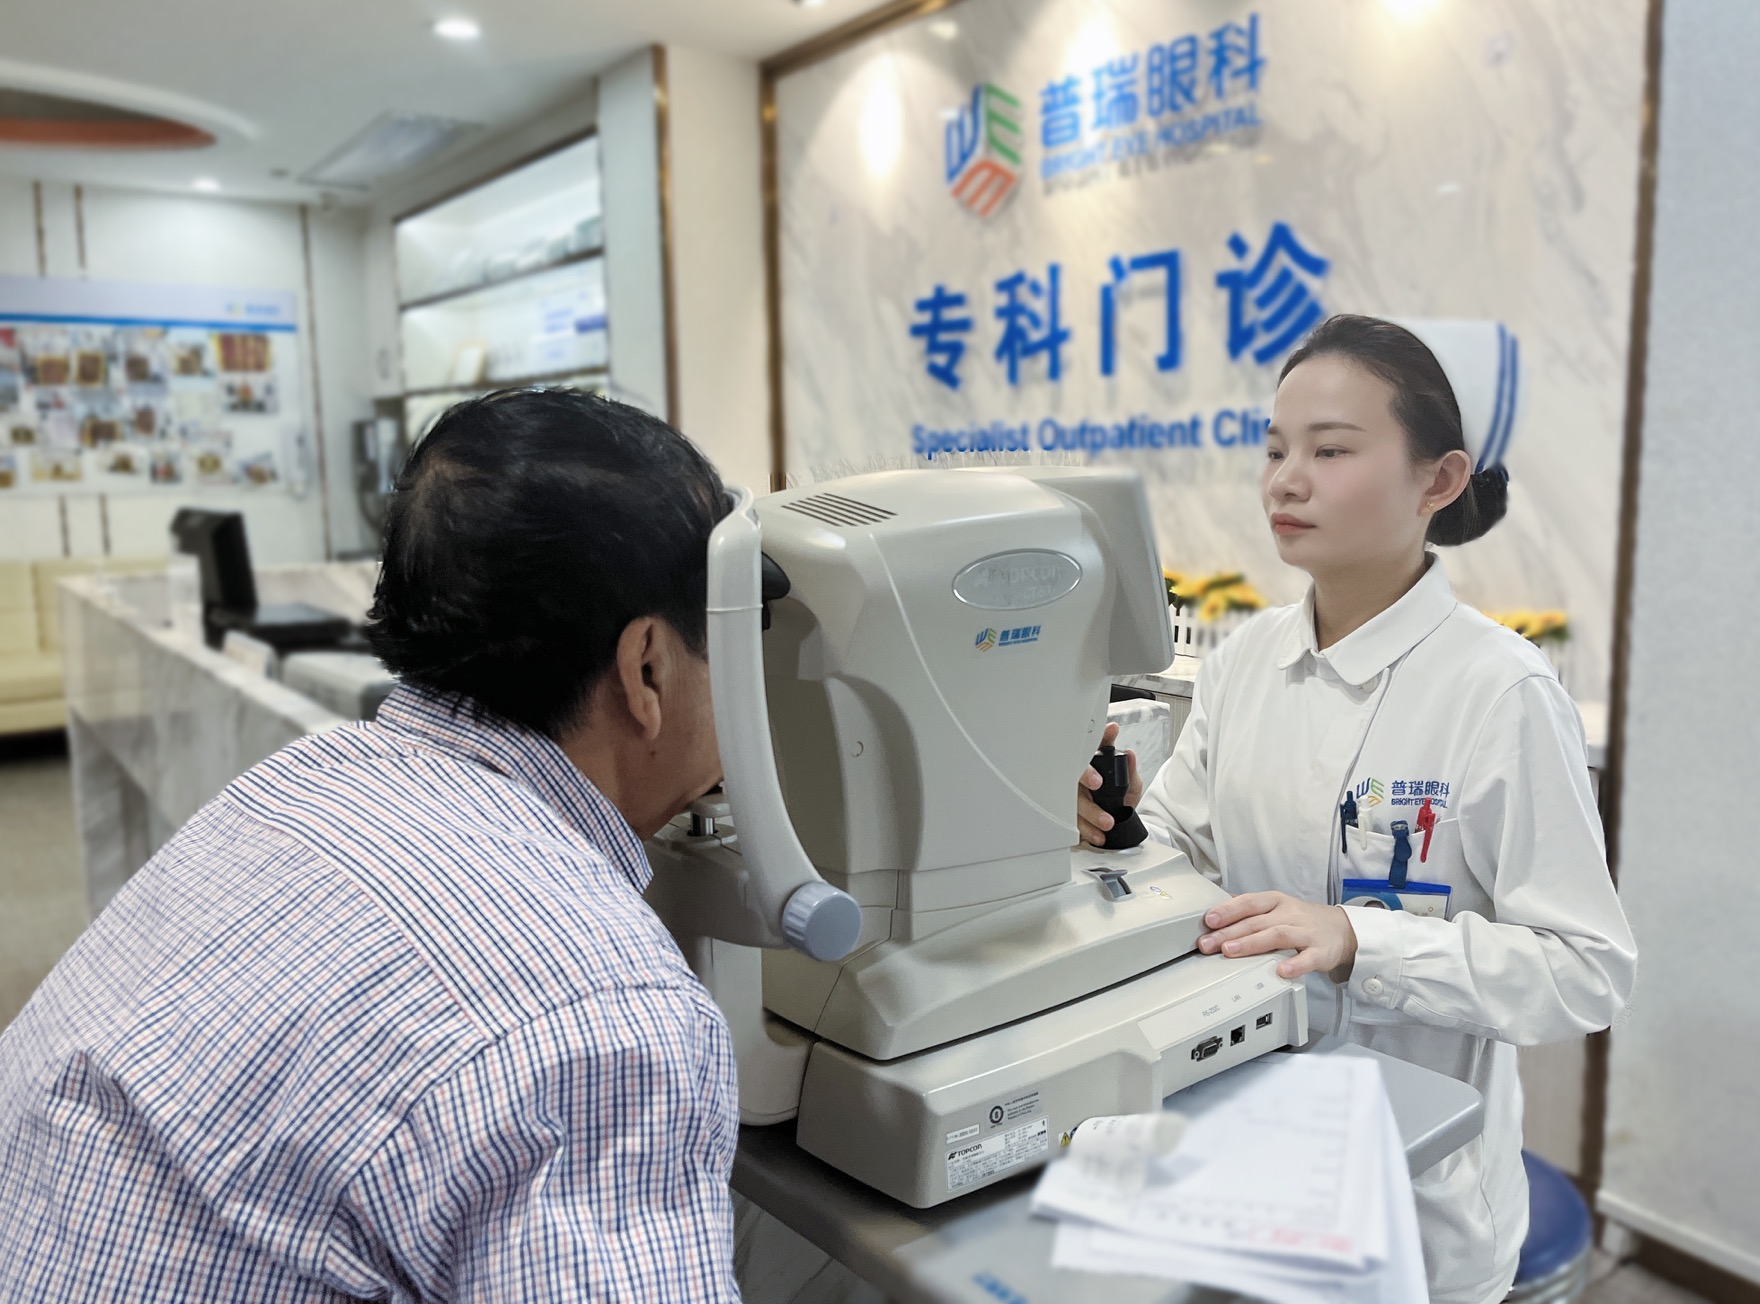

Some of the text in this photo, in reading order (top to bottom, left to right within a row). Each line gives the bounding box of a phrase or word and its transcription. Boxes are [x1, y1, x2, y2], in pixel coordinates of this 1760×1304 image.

[1039, 13, 1266, 149] 普瑞眼科
[1156, 100, 1264, 147] HOSPITAL
[909, 221, 1330, 390] 专科门诊
[911, 422, 1030, 460] Specialist
[1037, 412, 1203, 455] Outpatient
[1391, 780, 1450, 798] 普瑞眼科
[957, 1143, 983, 1157] TOPCON
